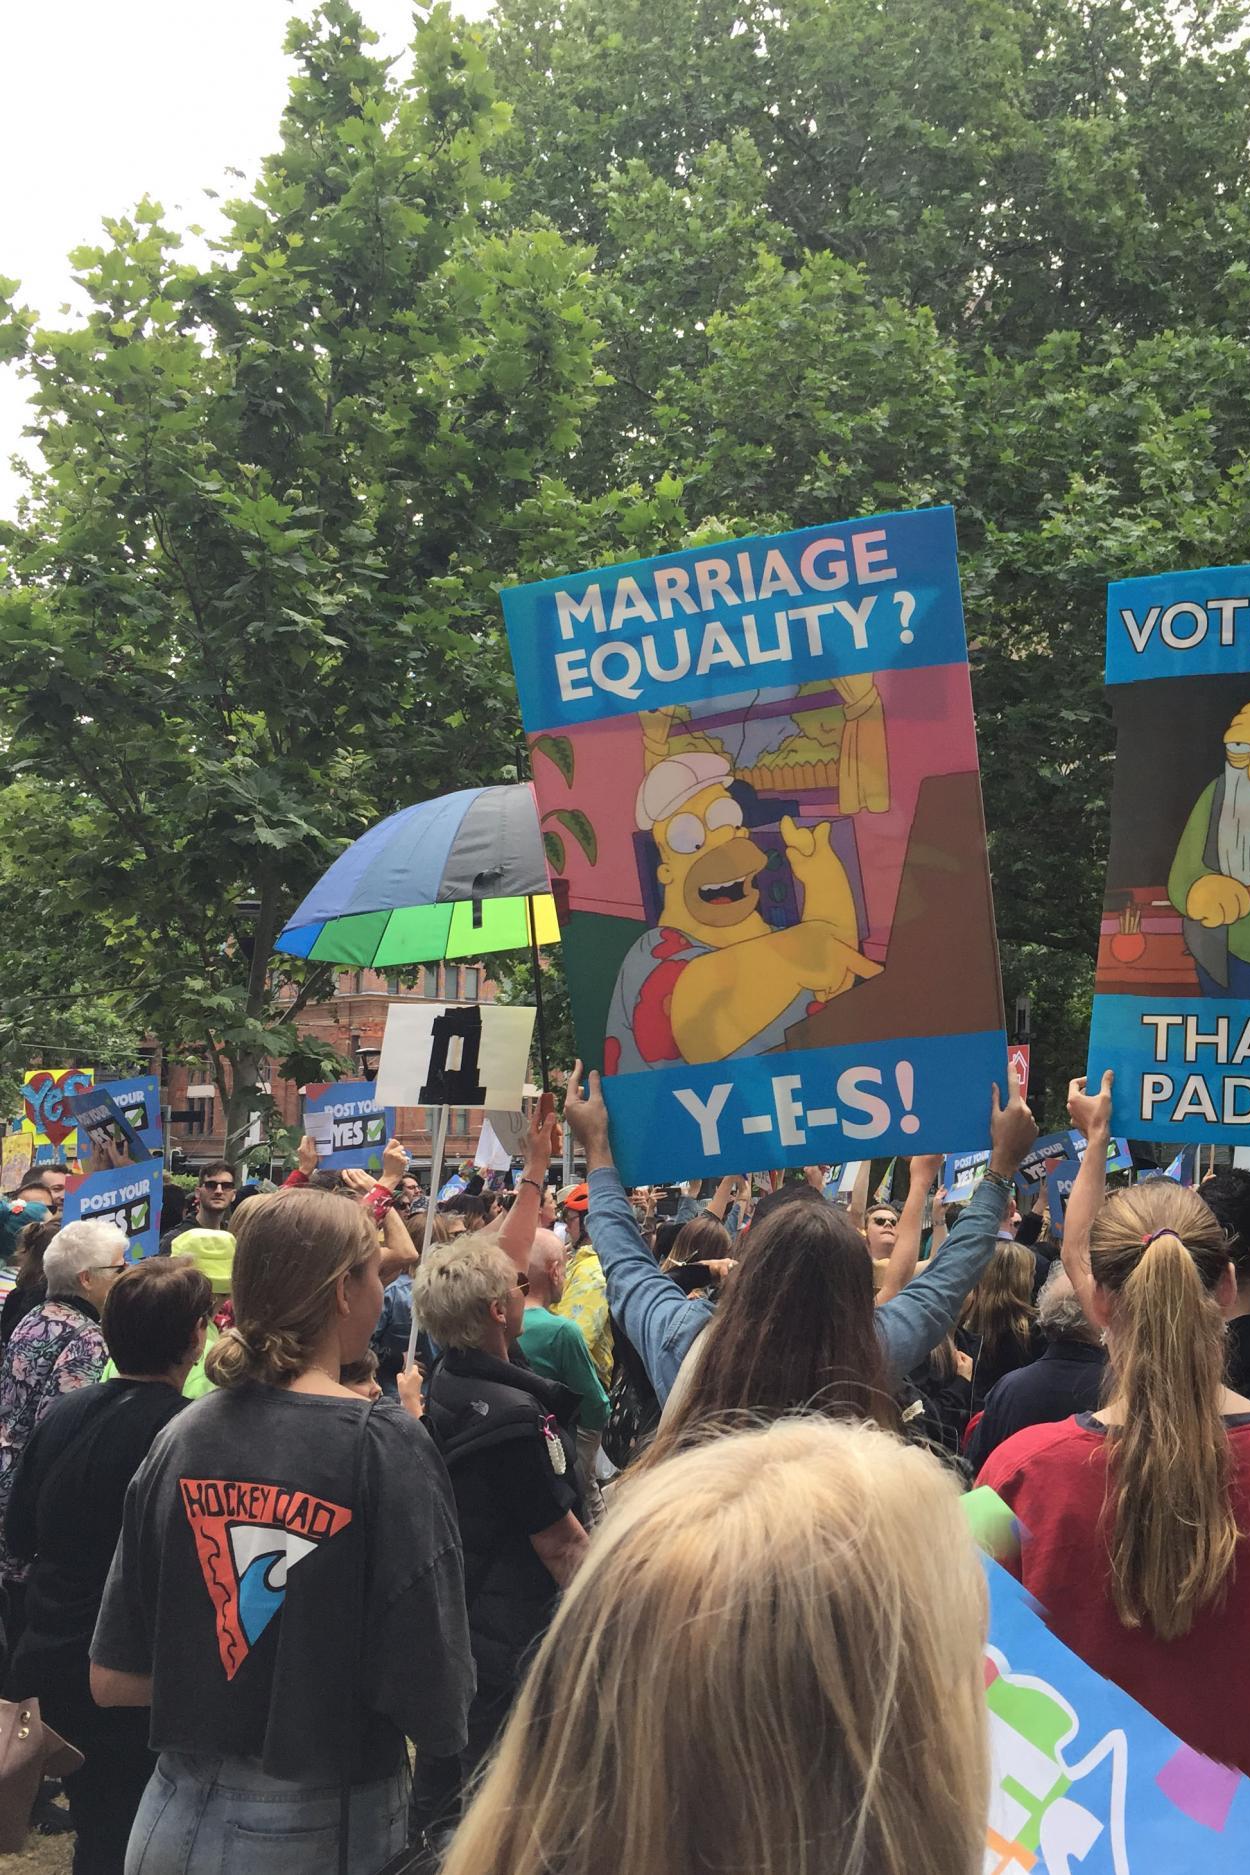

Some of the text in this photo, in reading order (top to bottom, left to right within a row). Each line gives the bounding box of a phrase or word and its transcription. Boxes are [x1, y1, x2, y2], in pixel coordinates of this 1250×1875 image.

[555, 529, 897, 640] MARRIAGE
[672, 1060, 920, 1156] Y-E-S!
[331, 1120, 363, 1147] YES
[80, 1179, 150, 1213] POST YOUR
[183, 1482, 271, 1520] HOCKEY
